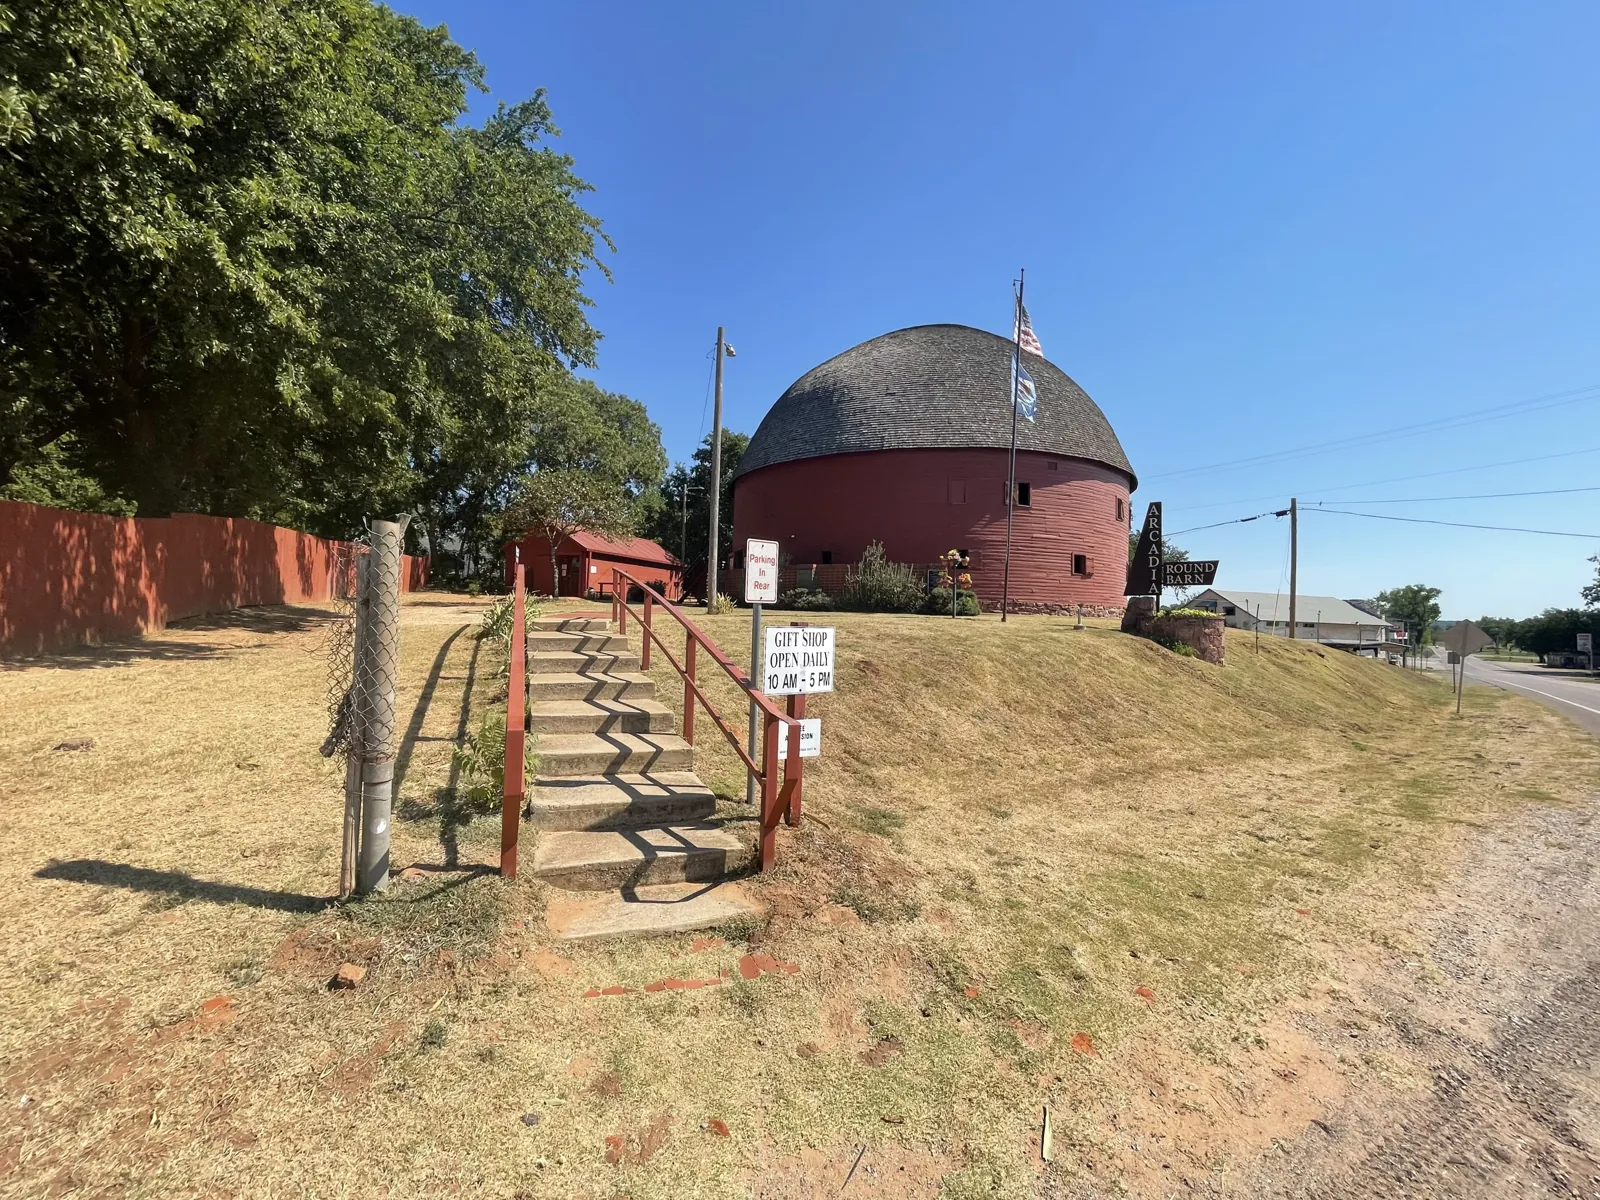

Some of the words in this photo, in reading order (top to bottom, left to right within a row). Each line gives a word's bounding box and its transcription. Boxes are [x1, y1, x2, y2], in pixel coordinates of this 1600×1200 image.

[1148, 504, 1160, 594] ARCADIA
[750, 554, 776, 566] Parking
[758, 567, 766, 577] In
[1166, 563, 1215, 574] ROUND
[753, 580, 770, 590] Rear
[1166, 574, 1204, 584] BARN
[774, 631, 800, 648] GIFT
[802, 631, 828, 647] SHOP
[769, 652, 799, 669] OPEN
[802, 651, 830, 667] DAILY
[767, 673, 779, 690] 10
[782, 673, 798, 689] AM
[809, 672, 816, 688] 5
[818, 671, 831, 687] PM
